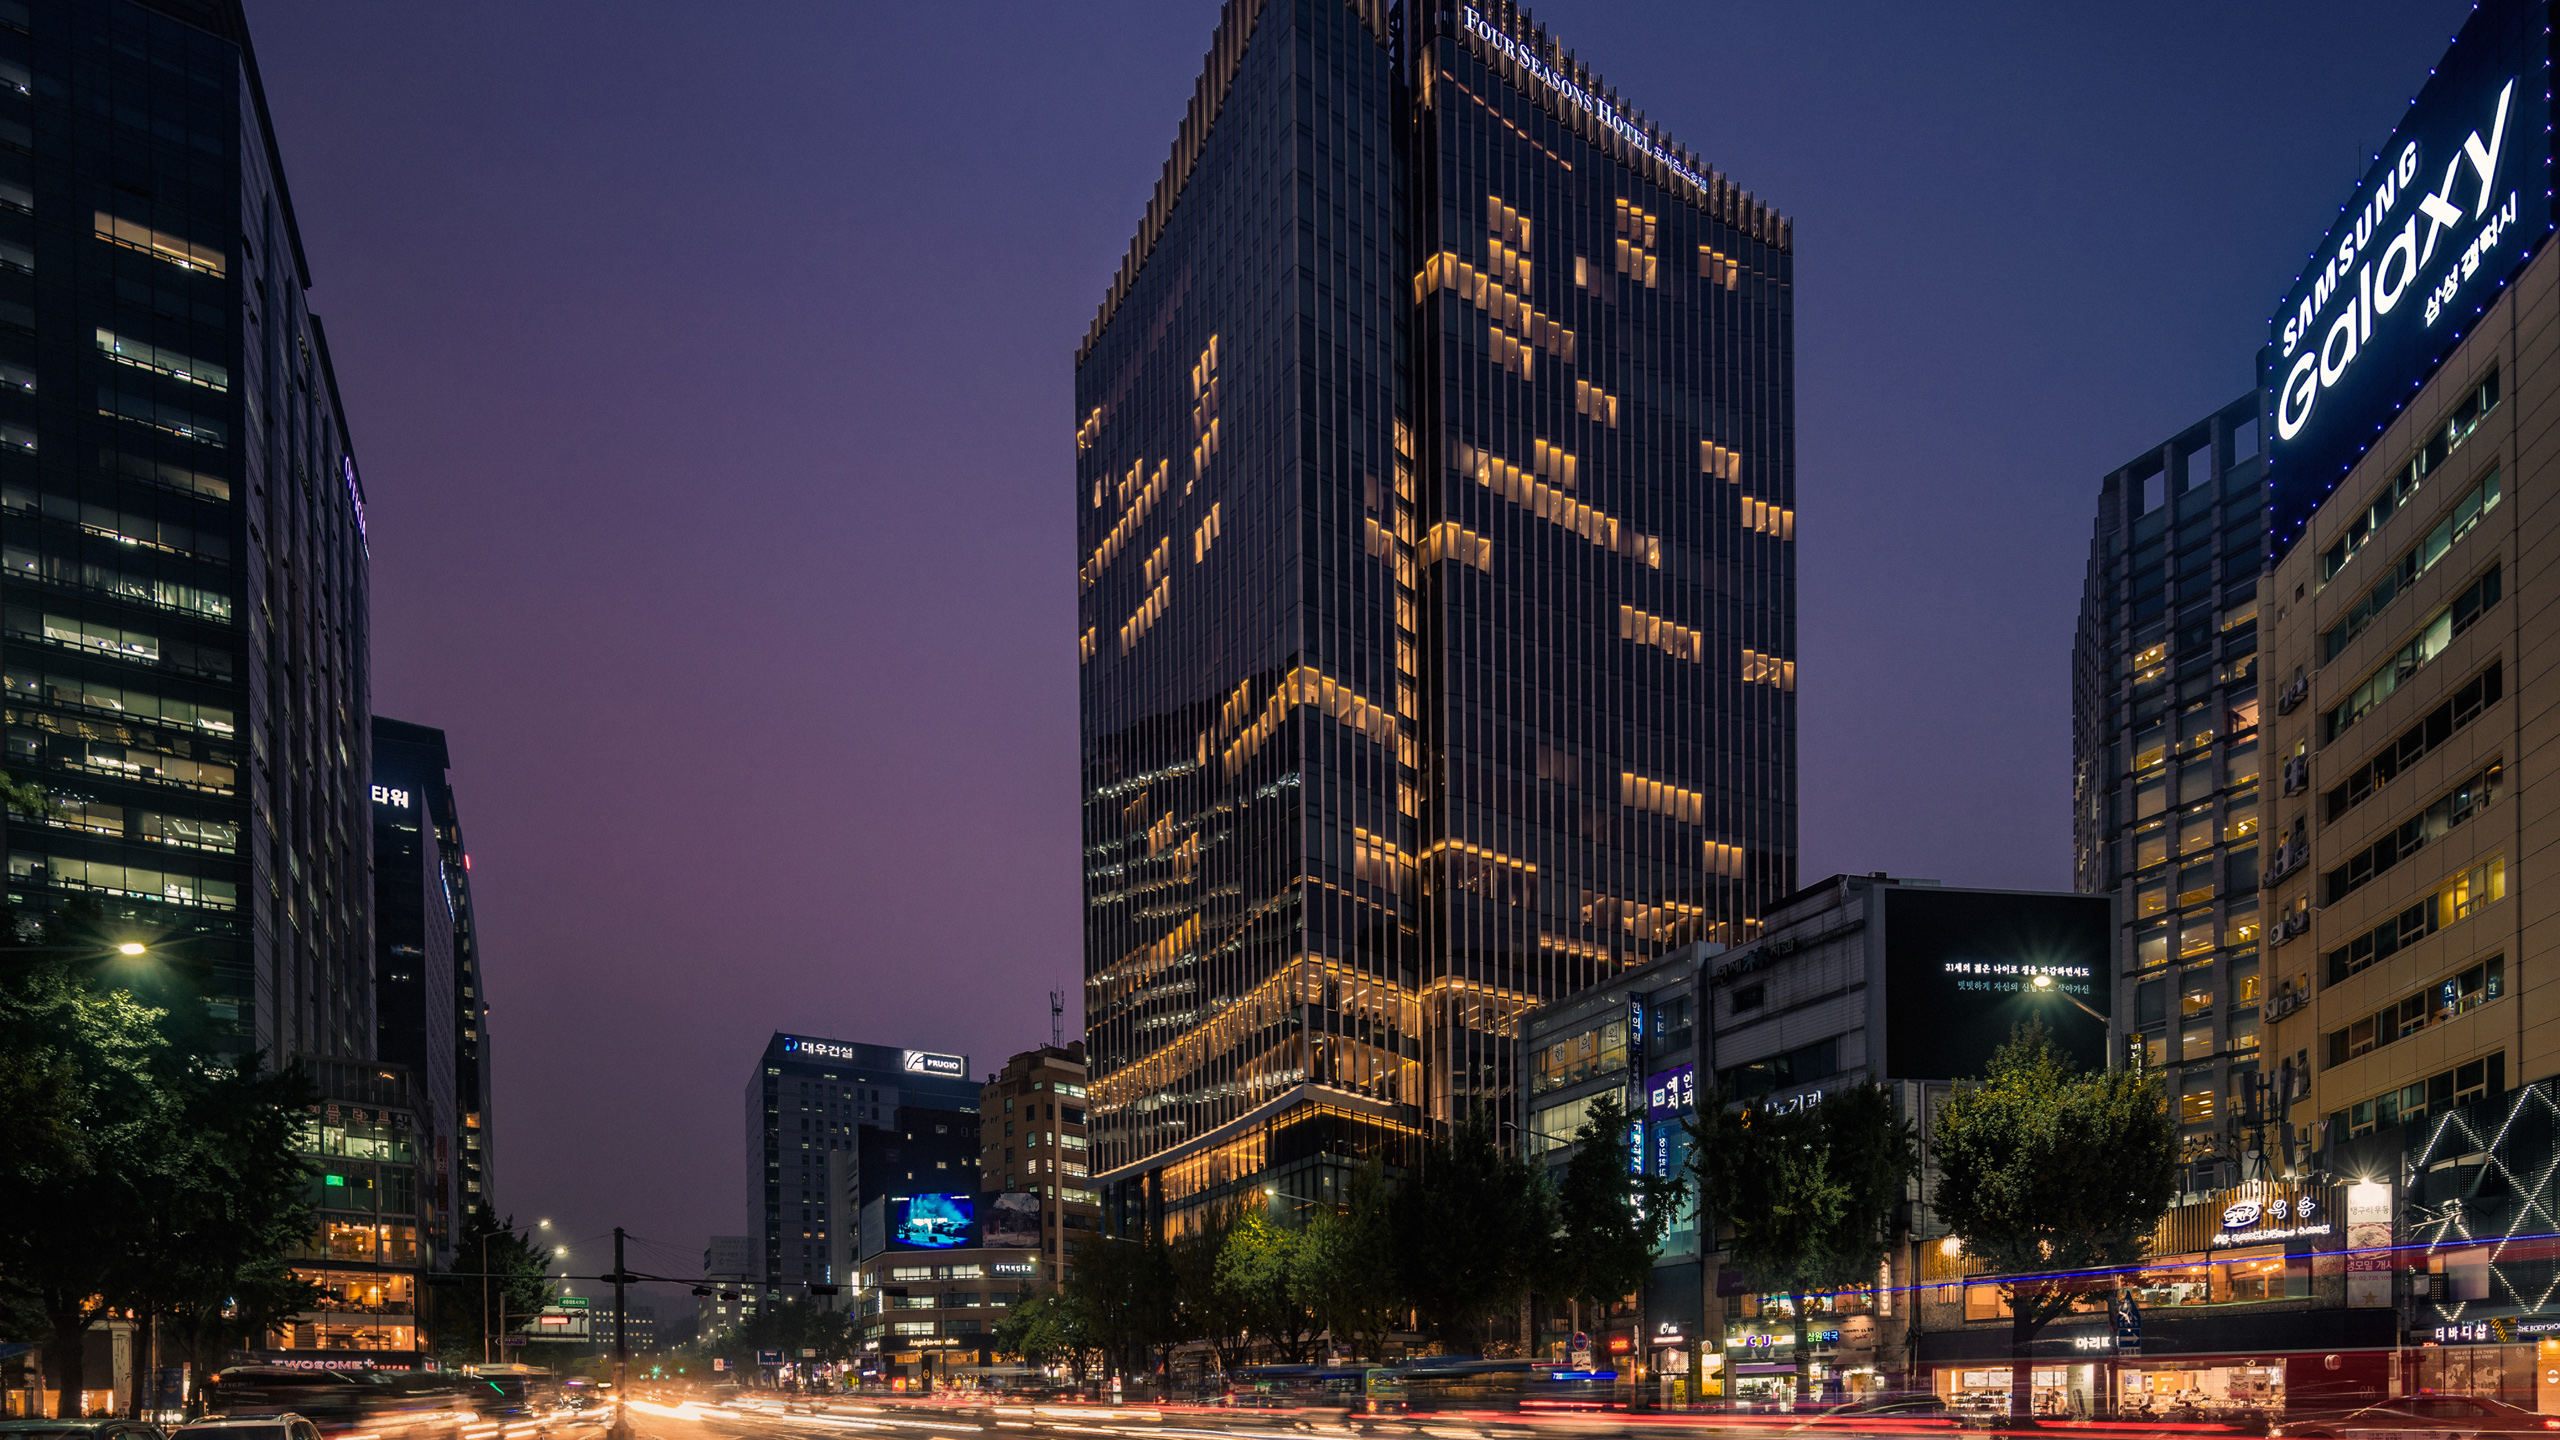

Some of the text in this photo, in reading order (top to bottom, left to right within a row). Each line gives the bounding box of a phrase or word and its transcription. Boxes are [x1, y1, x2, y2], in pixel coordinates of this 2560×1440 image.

[1464, 5, 1653, 156] FOUR SEASONS HOTEL
[2283, 140, 2417, 358] SAMSUNG
[2277, 77, 2514, 441] Galaxy
[371, 785, 409, 808] 타워
[1945, 963, 1971, 973] 31세의
[1993, 964, 2018, 974] 나이로
[1993, 981, 2018, 992] 자신의
[1632, 1002, 1641, 1045] 한의원
[801, 1041, 853, 1059] 대우건설
[927, 1058, 959, 1069] PRUGIO
[2435, 1323, 2487, 1341] 더바디샵
[2546, 1323, 2560, 1331] SHO
[1748, 1334, 1772, 1347] CU
